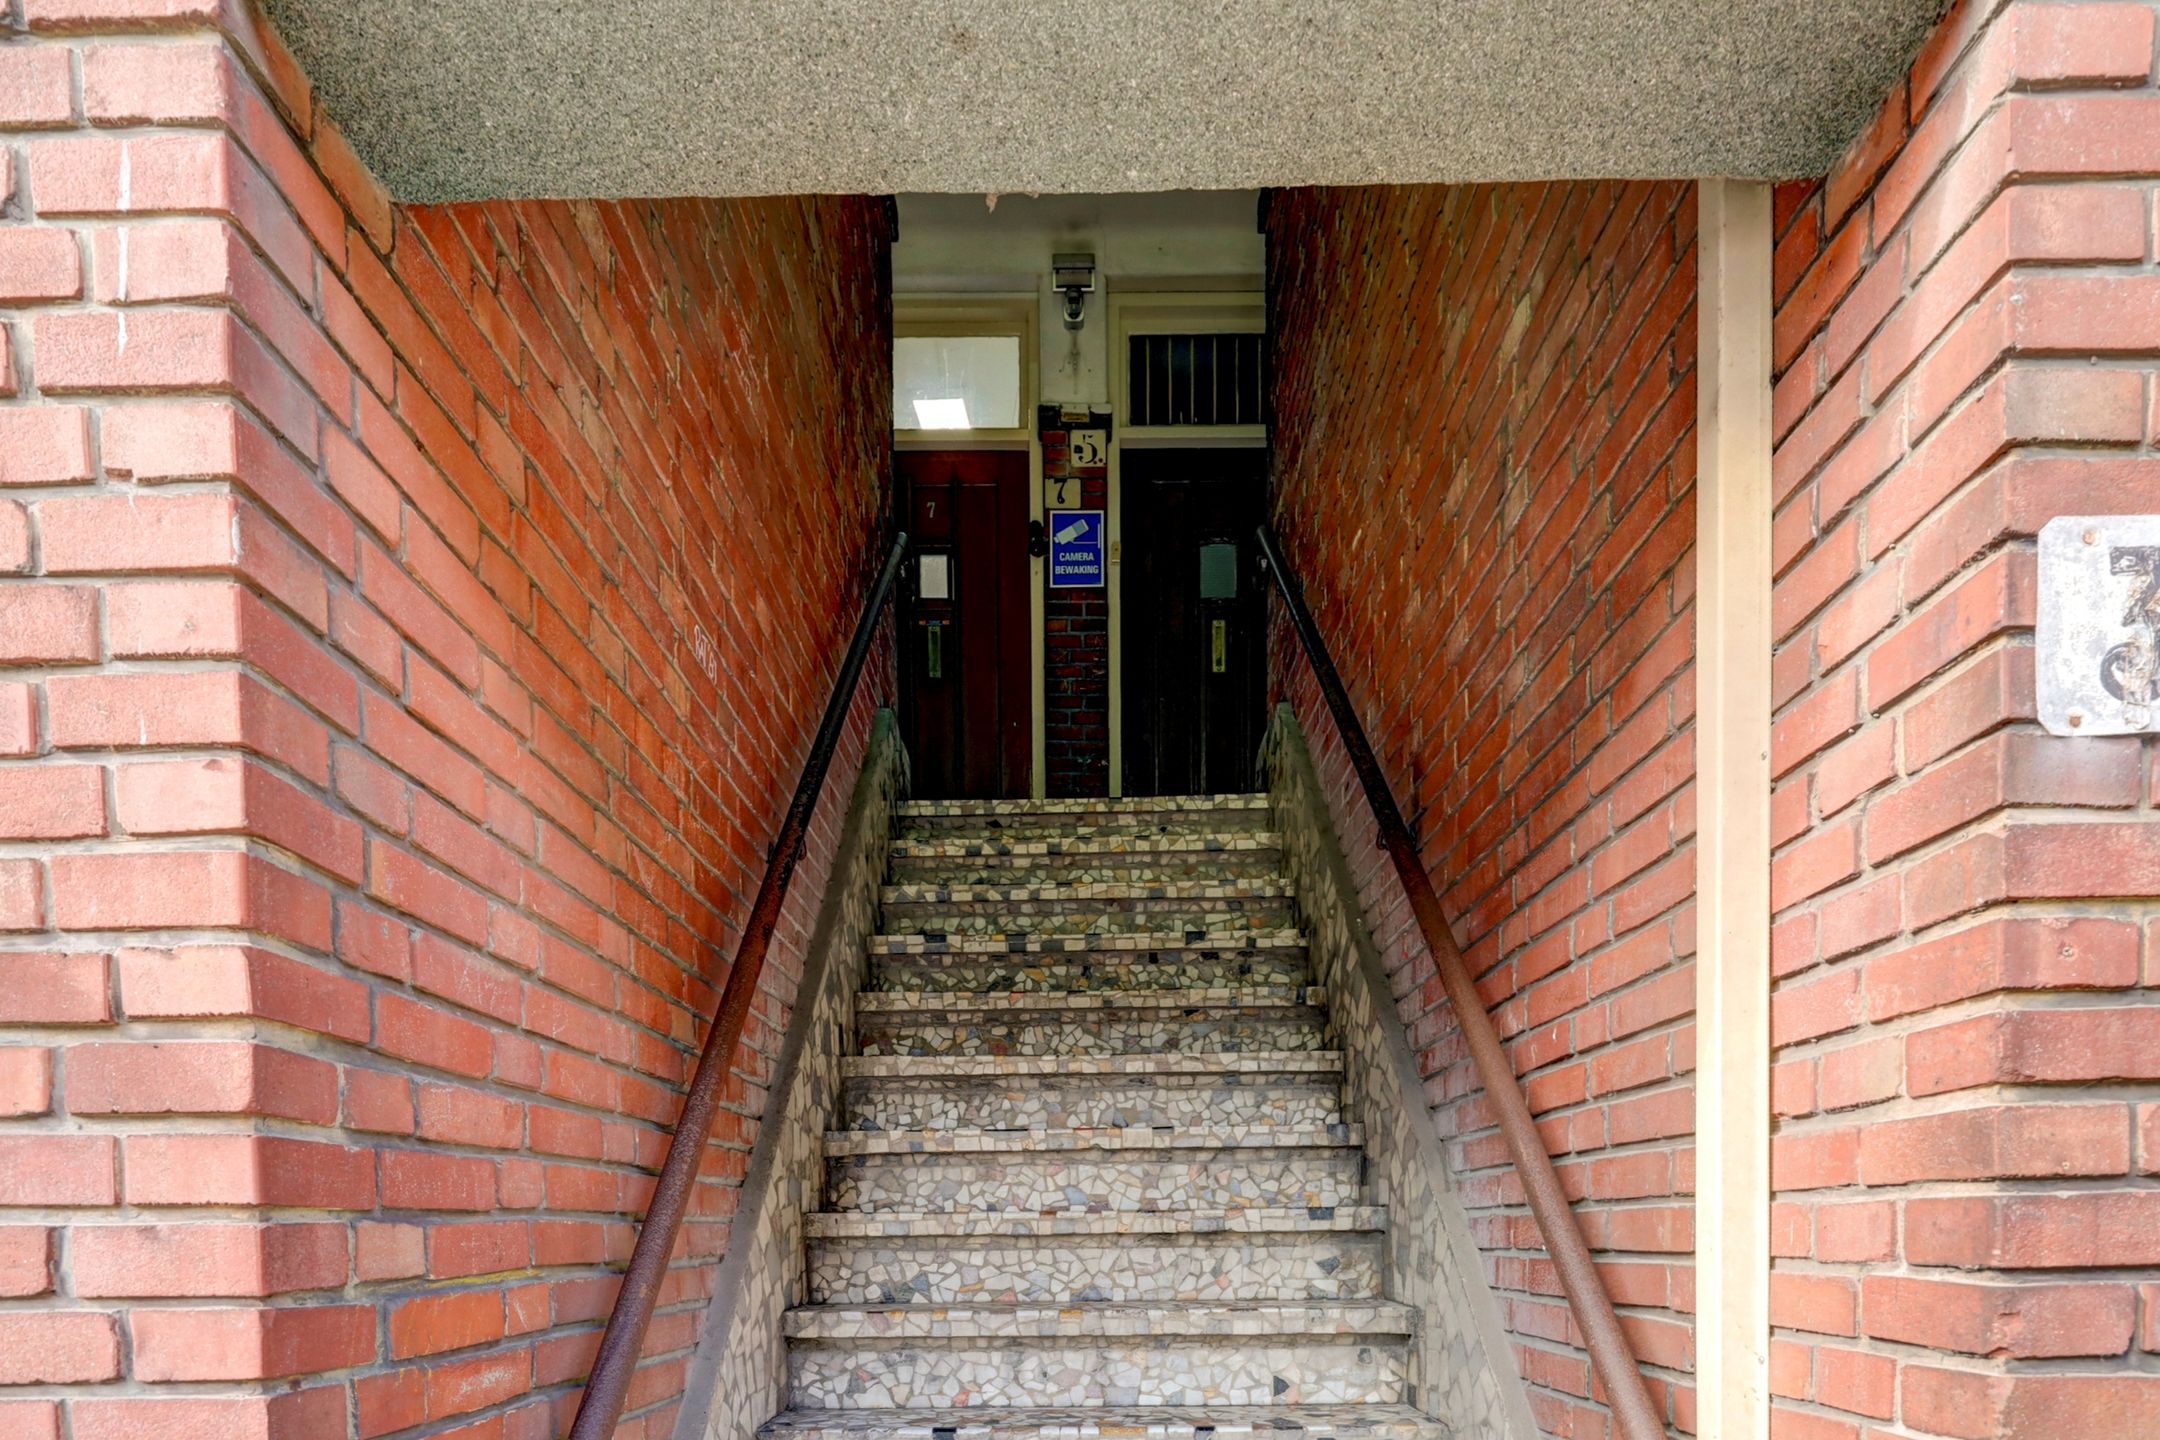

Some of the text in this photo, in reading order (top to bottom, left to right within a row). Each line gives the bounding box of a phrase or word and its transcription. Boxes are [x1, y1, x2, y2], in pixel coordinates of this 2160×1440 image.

[1078, 434, 1098, 464] 5
[1053, 477, 1068, 505] 7
[926, 501, 936, 519] 7
[1059, 552, 1095, 562] CAMERA
[1055, 565, 1099, 575] BEWAKING
